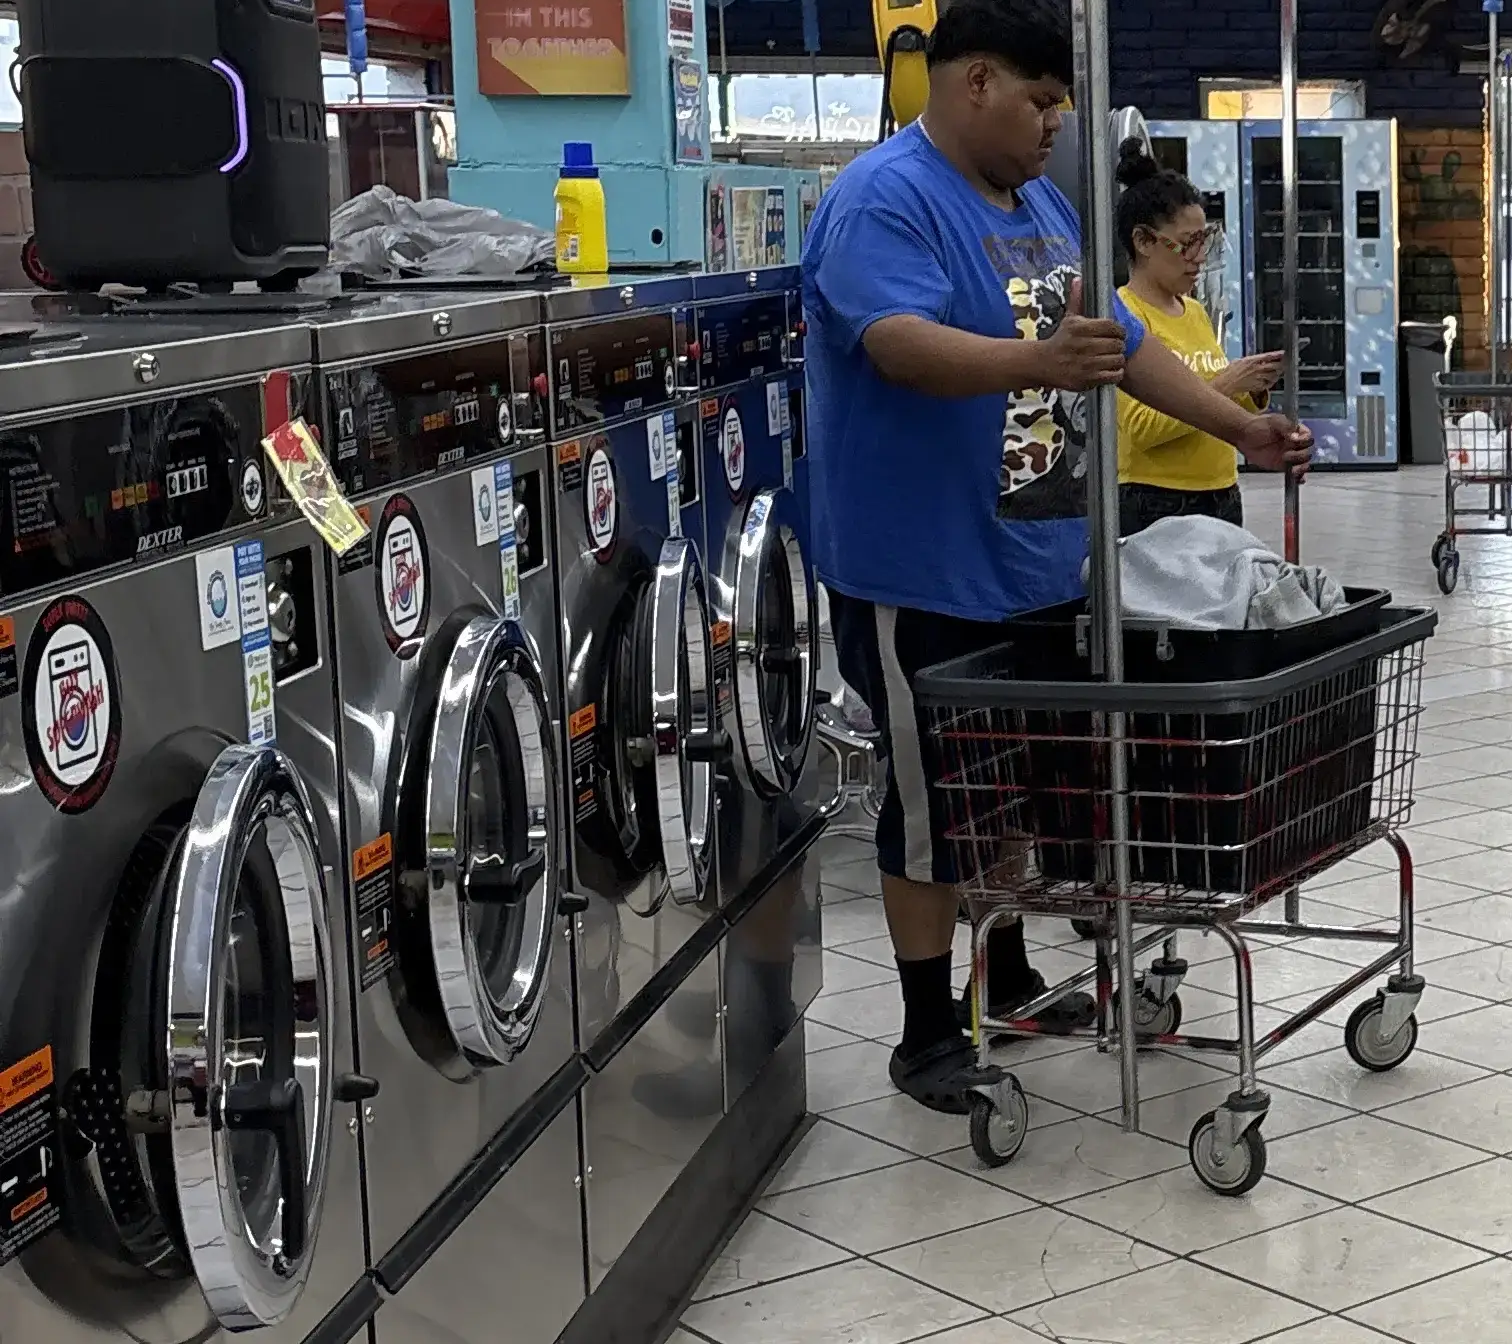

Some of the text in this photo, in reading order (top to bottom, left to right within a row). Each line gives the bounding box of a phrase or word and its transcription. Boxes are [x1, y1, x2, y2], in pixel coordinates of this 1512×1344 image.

[506, 7, 593, 28] IN THIS
[487, 37, 616, 57] TOGETHER
[136, 525, 183, 553] DEXTER
[504, 565, 517, 597] 26
[249, 670, 271, 713] 25
